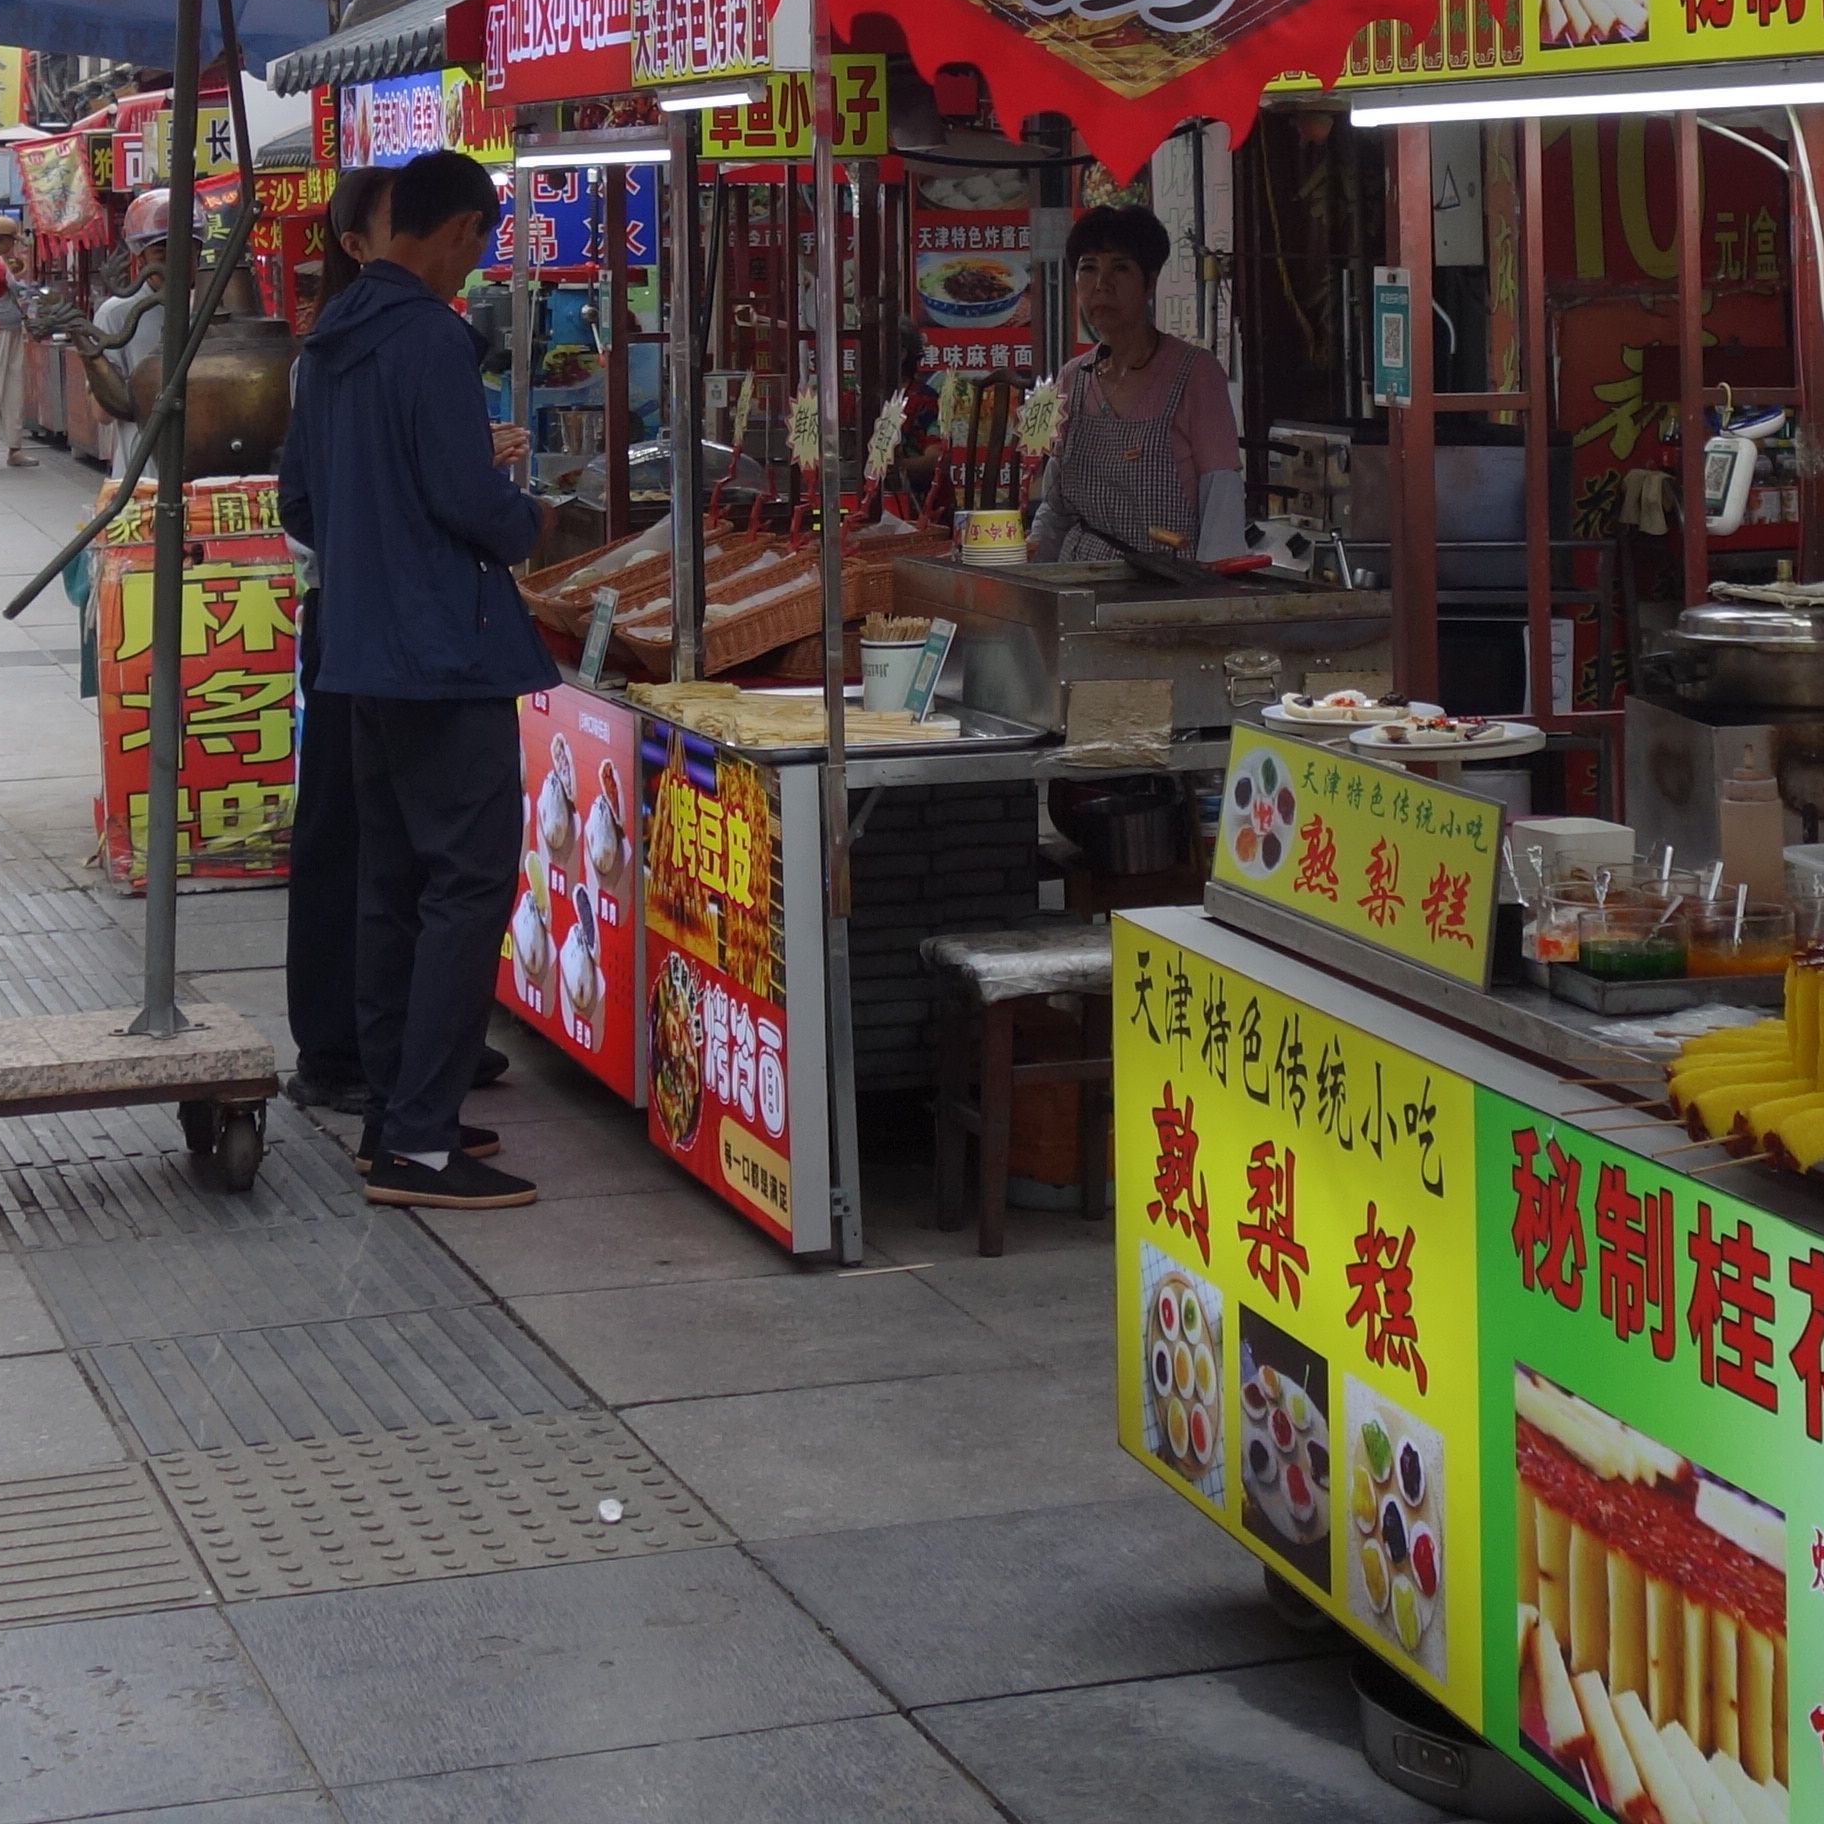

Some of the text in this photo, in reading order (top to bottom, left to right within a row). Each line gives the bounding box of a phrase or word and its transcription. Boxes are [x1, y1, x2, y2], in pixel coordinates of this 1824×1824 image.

[918, 226, 1031, 251] 天津特色炸酱面
[671, 778, 755, 909] 烤豆皮
[1298, 764, 1489, 856] 天津特色传统小吃
[1293, 814, 1478, 952] 熟梨糕
[703, 981, 785, 1139] 烤冷面
[1130, 949, 1444, 1199] 天津特色传统小吃
[1146, 1080, 1429, 1397] 熟梨糕
